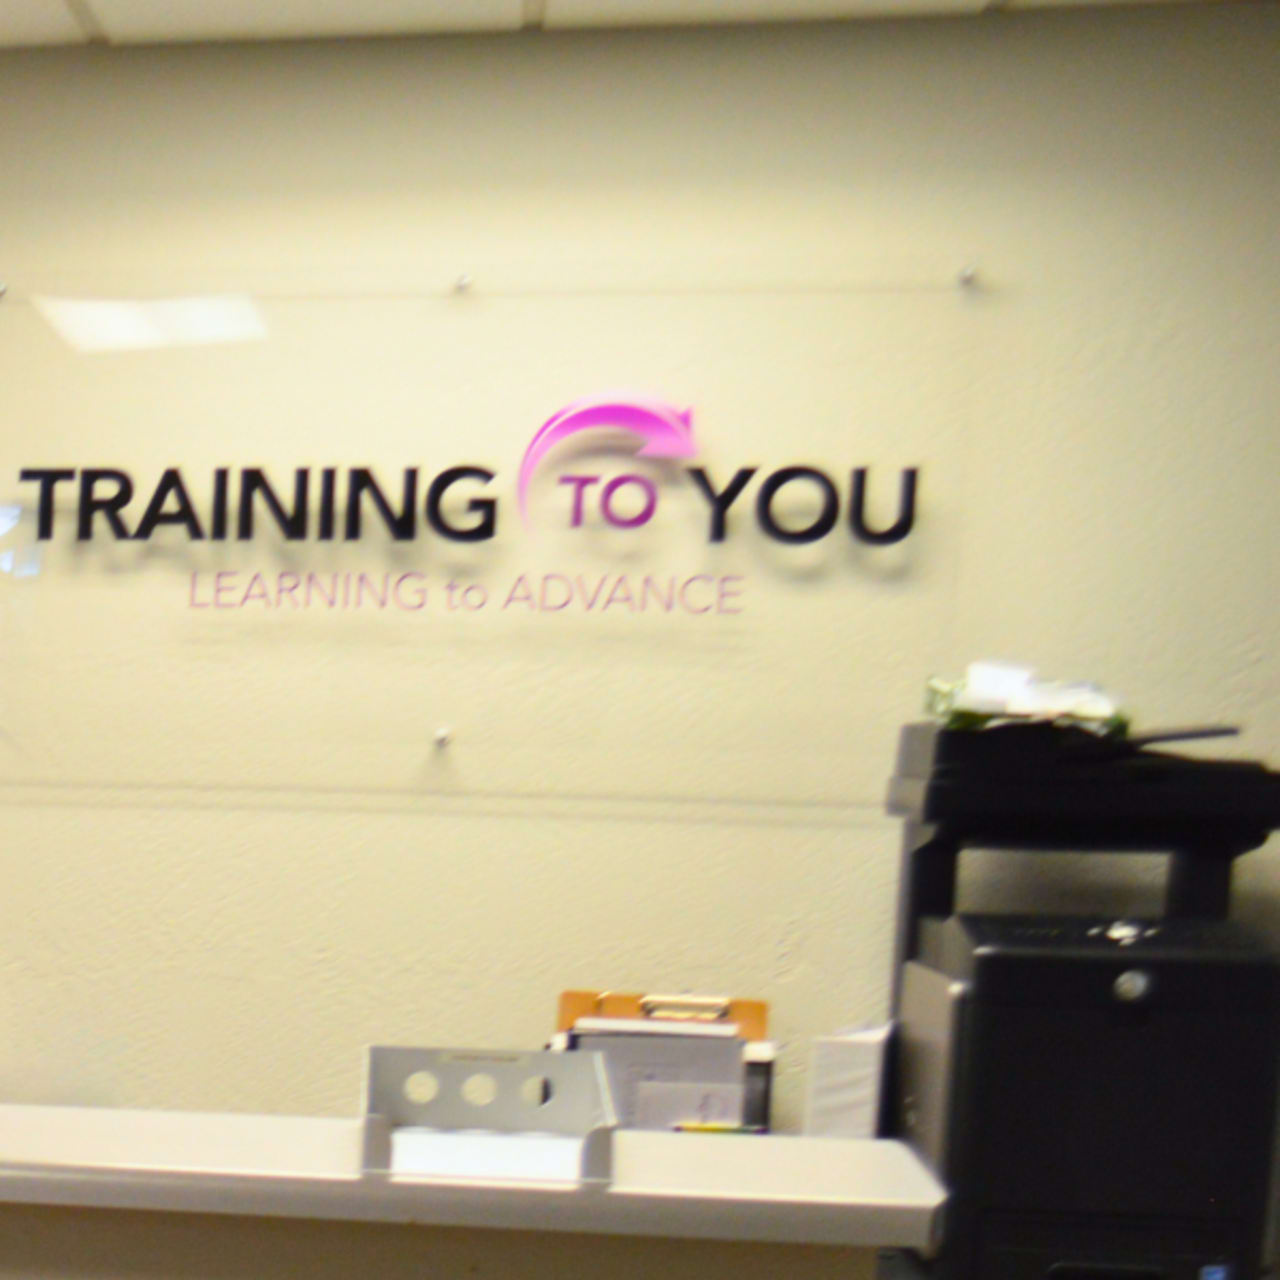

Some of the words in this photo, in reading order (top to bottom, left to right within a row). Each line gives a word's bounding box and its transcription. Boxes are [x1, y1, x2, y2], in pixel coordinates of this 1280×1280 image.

[19, 467, 498, 543] TRAINING
[557, 473, 658, 529] TO
[687, 465, 919, 545] YOU
[189, 570, 429, 611] LEARNING
[445, 577, 488, 611] to
[502, 572, 746, 614] ADVANCE
